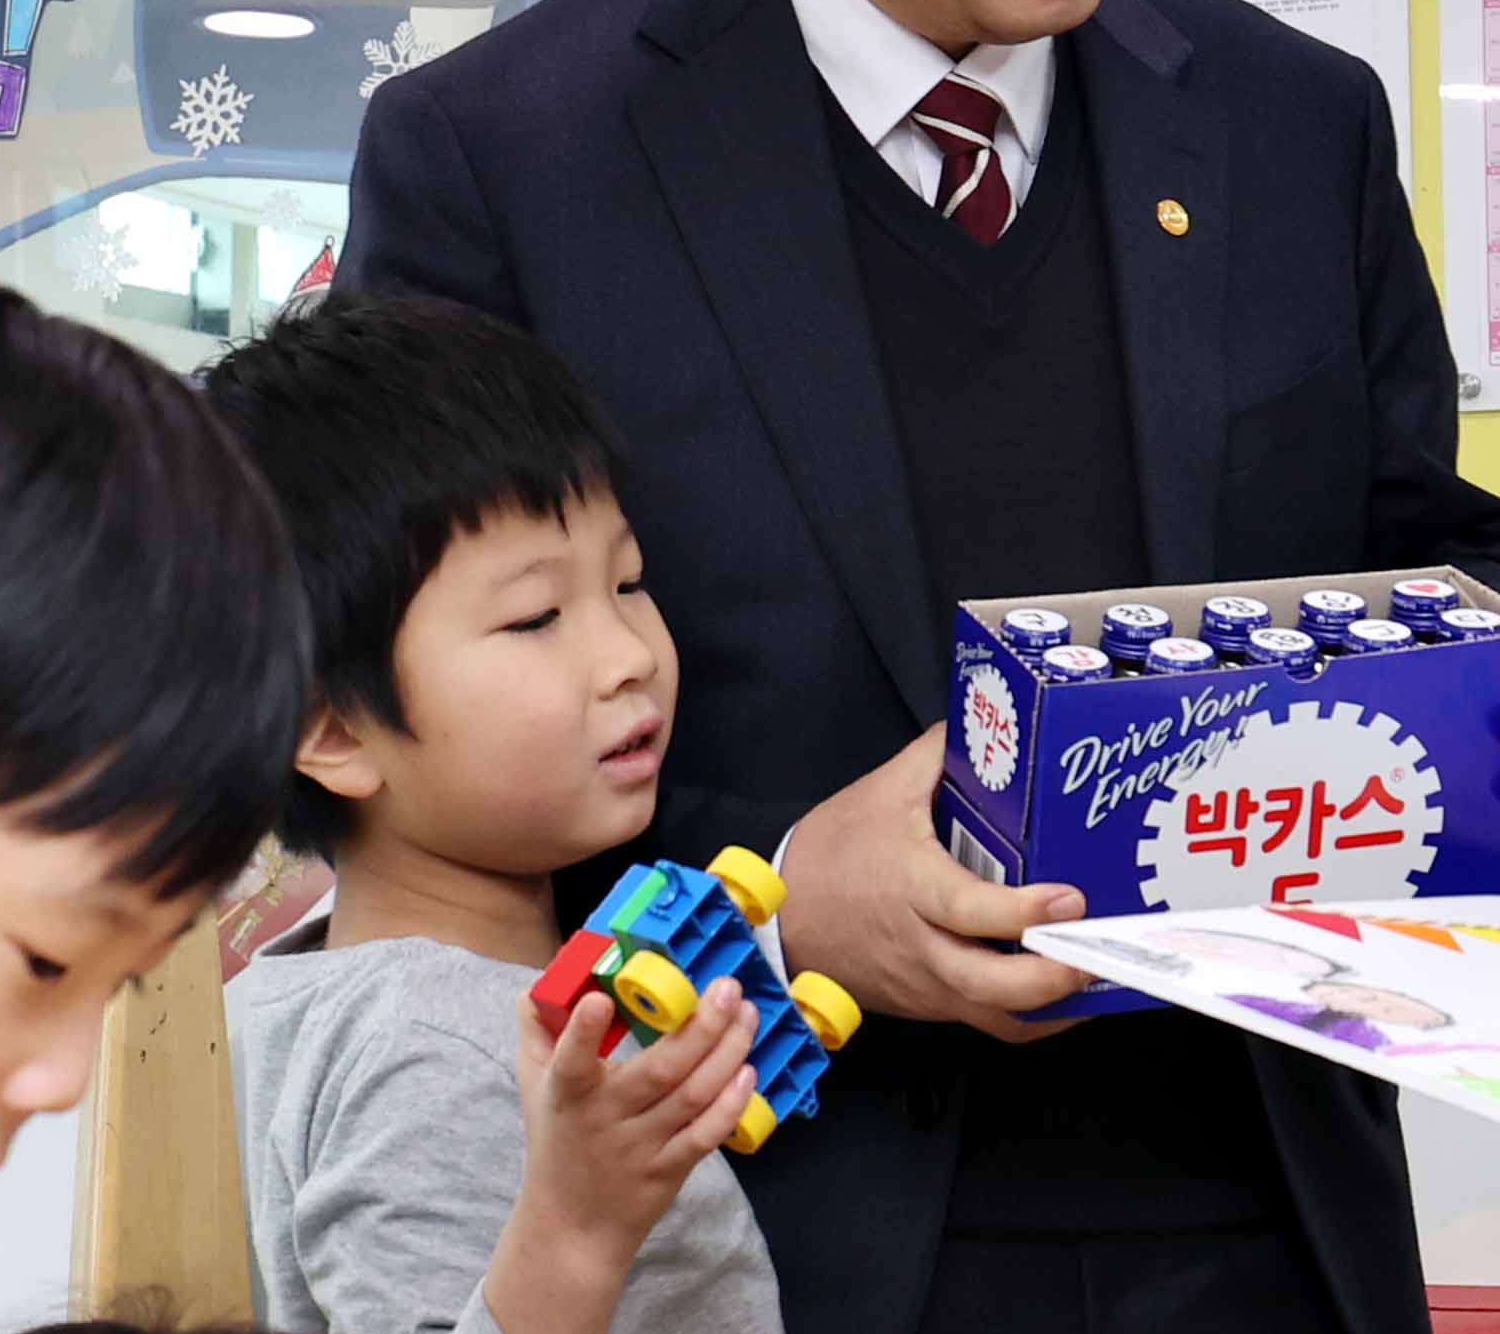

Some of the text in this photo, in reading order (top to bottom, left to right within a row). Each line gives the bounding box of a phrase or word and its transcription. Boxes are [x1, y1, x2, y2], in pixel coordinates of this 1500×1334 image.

[1060, 681, 1268, 795] Drive Your
[1086, 715, 1254, 831] Energy!
[1185, 772, 1405, 869] 박카스
